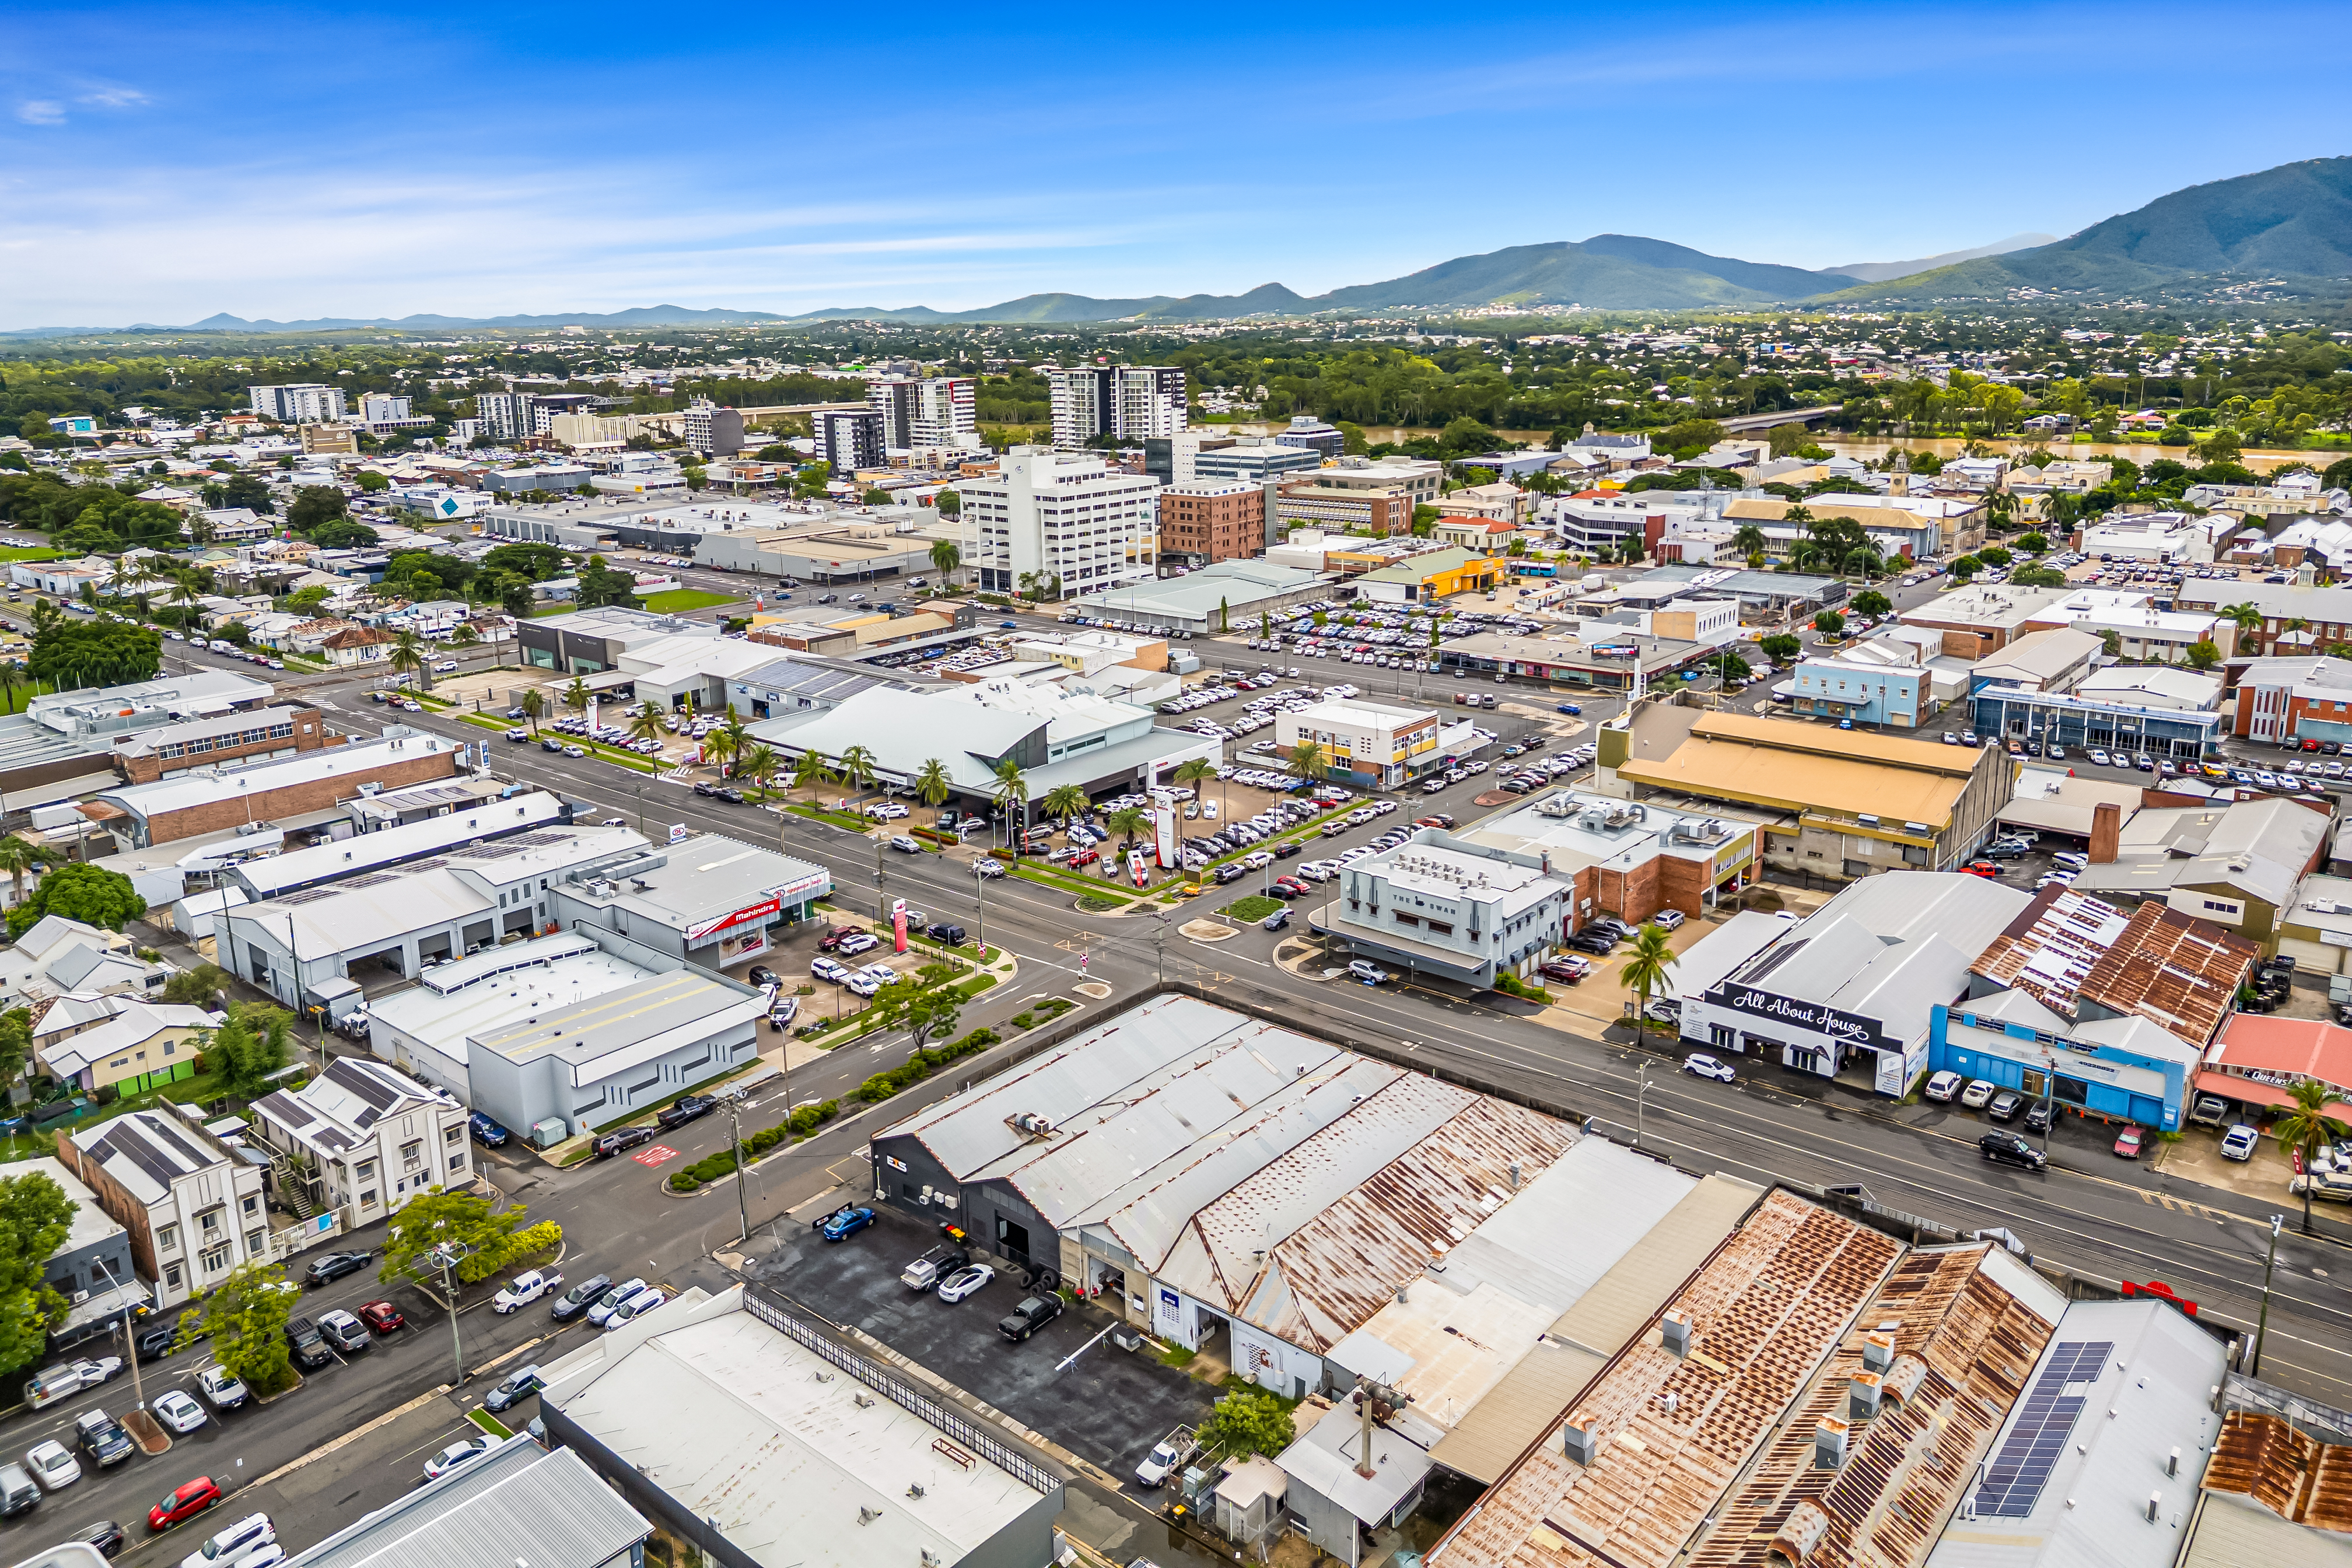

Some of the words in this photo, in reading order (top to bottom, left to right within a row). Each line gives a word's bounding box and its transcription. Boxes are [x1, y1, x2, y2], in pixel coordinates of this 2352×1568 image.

[787, 883, 809, 895] opposite
[736, 904, 775, 921] Mahindra
[1393, 894, 1410, 904] THE
[1430, 903, 1456, 915] SWAN
[1732, 990, 1765, 1012] All
[1766, 998, 1814, 1023] About
[1816, 1009, 1870, 1041] House
[635, 1146, 677, 1164] STOP
[887, 1155, 907, 1172] ETS
